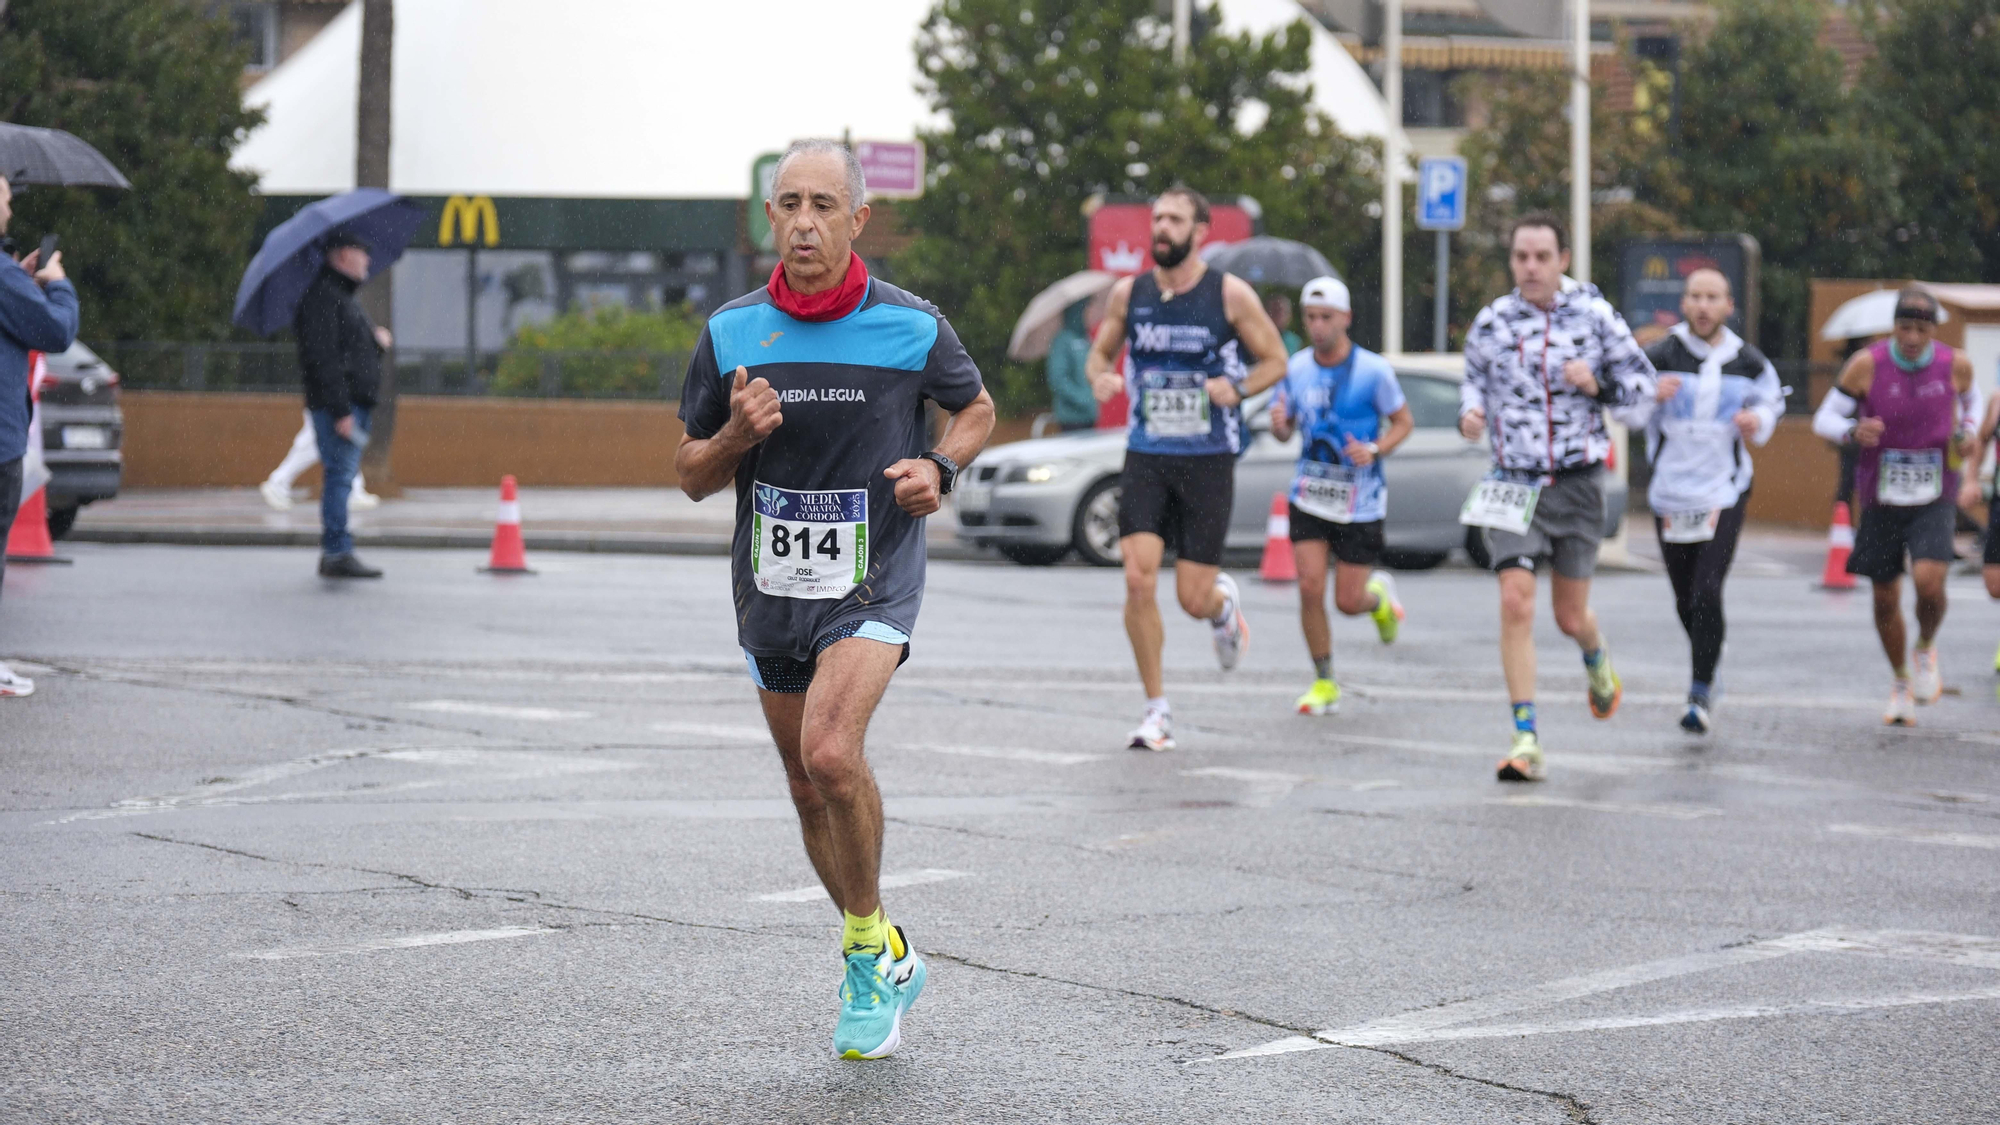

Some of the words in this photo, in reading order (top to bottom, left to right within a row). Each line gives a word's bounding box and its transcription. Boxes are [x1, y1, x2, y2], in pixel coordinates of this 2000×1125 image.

[775, 389, 818, 403] MEDIA
[821, 388, 866, 402] LEGUA
[763, 497, 780, 517] 59
[800, 494, 841, 505] MEDIA
[853, 493, 861, 518] 2025
[771, 524, 841, 561] 814
[795, 568, 813, 576] JOSE
